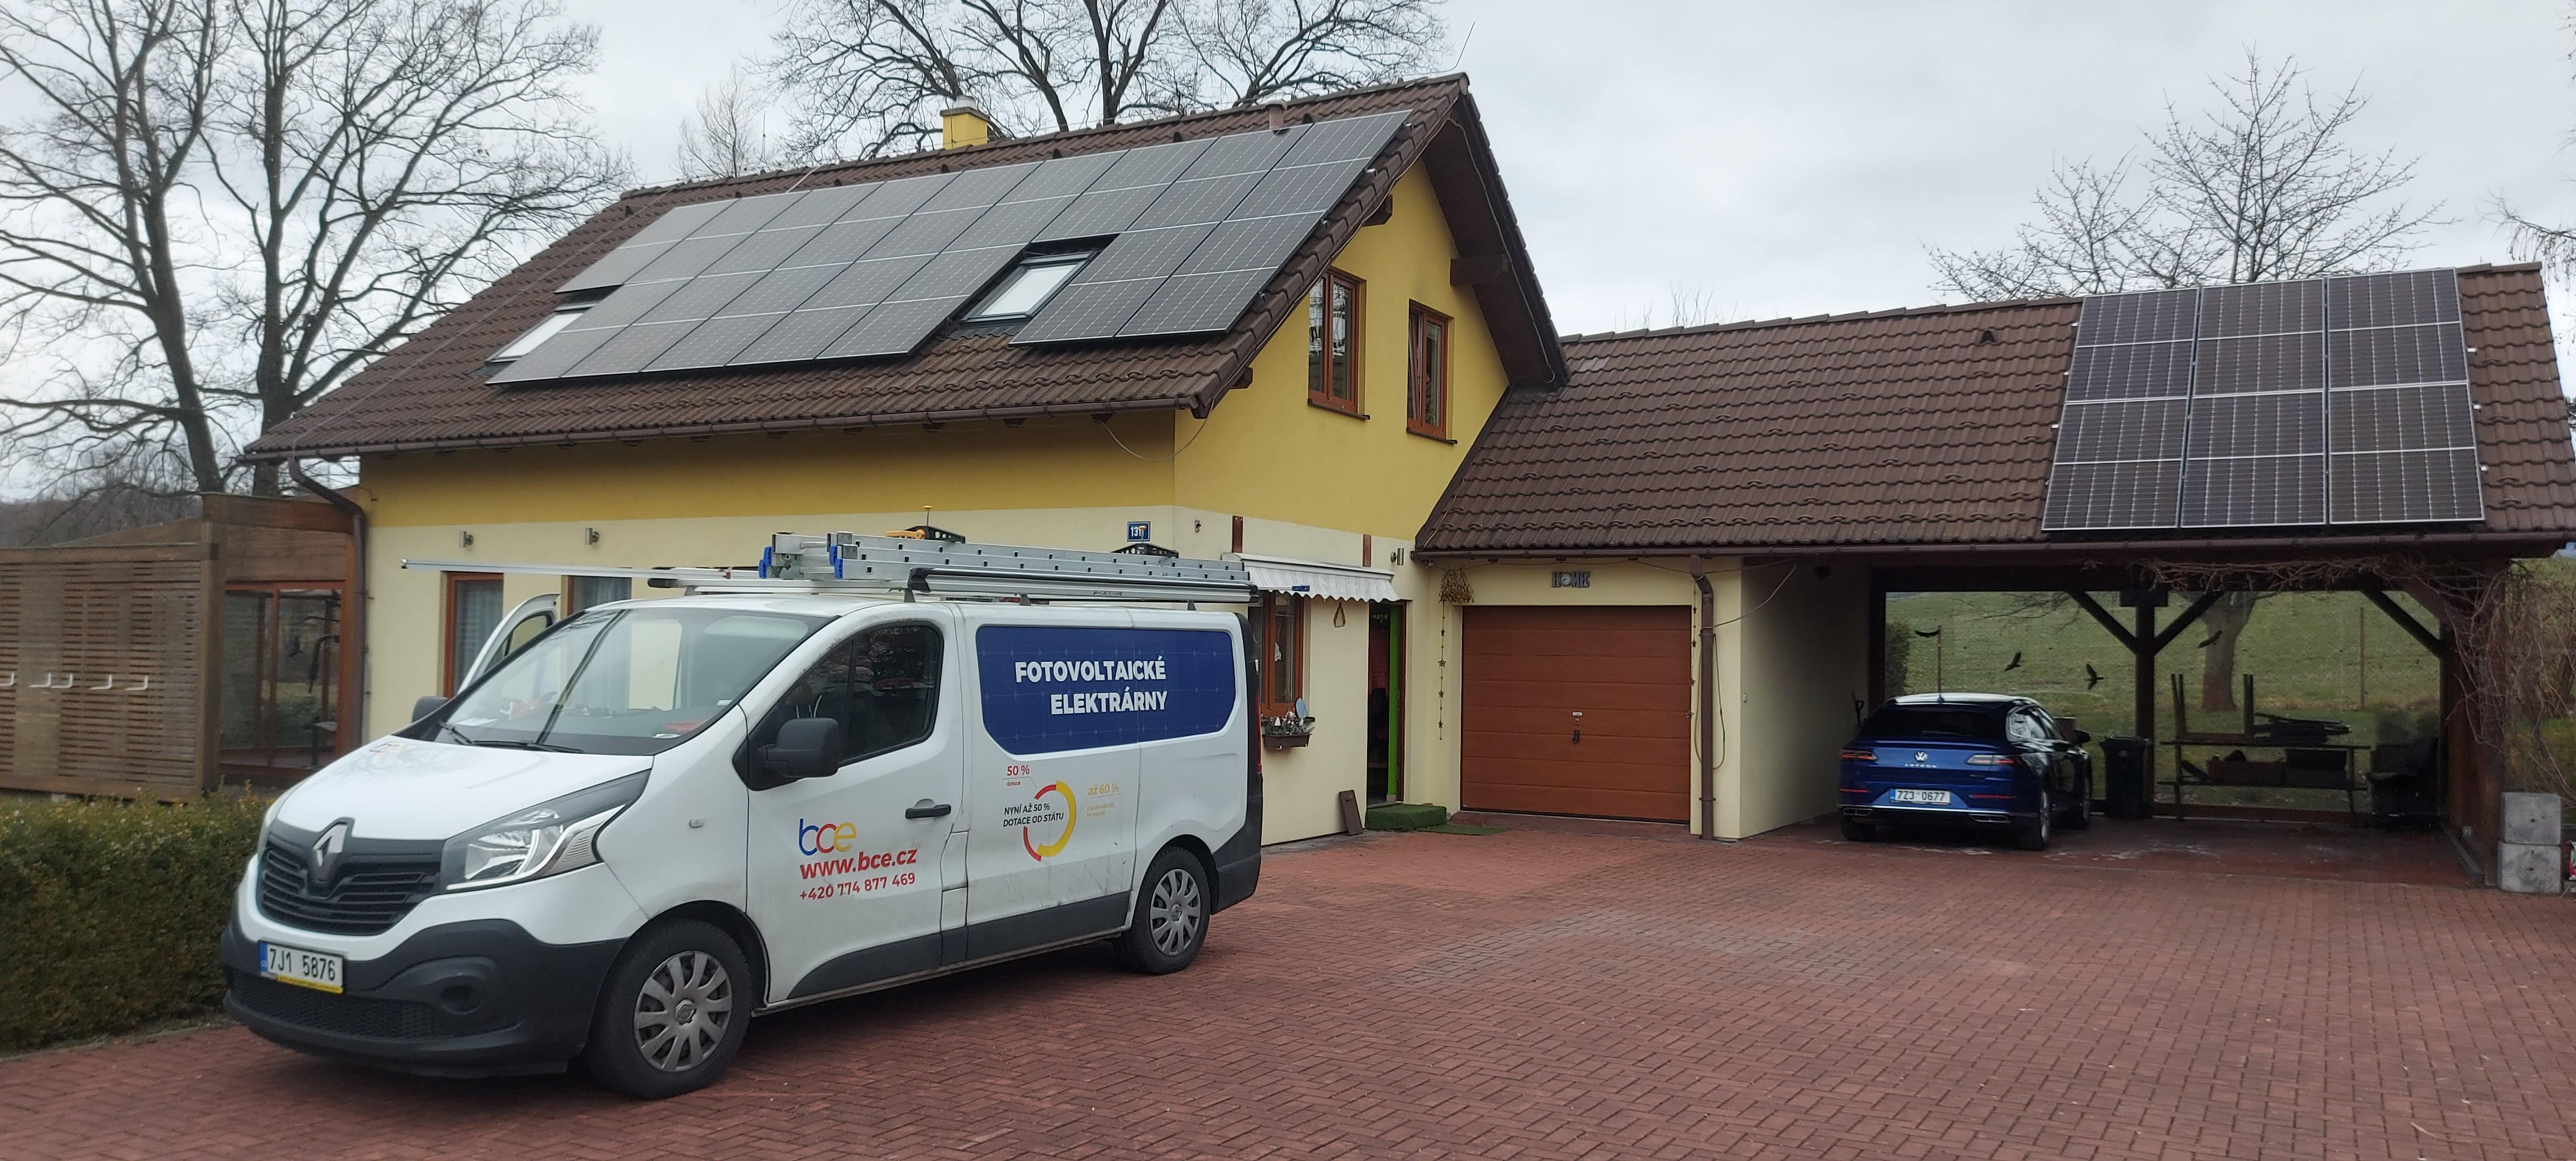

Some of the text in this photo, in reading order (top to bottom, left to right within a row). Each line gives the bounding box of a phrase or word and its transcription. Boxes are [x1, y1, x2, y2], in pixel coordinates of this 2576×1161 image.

[1015, 655, 1166, 682] FOTOVOLTAICKÉ
[1051, 686, 1167, 715] ELEKTRÁRNY
[1007, 765, 1030, 776] 50 %
[1099, 784, 1110, 794] 60
[1111, 782, 1119, 793] %
[1897, 790, 1945, 801] 7Z3 0677
[1003, 817, 1031, 827] DOTACE
[1043, 812, 1064, 822] STÁTU
[1004, 803, 1022, 815] NYNÍ
[1023, 803, 1032, 813] AŽ
[799, 818, 857, 856] bce
[799, 848, 918, 880] www.bce.cz
[800, 872, 915, 900] +420 774 877 469
[270, 949, 335, 981] 7J1 5876
